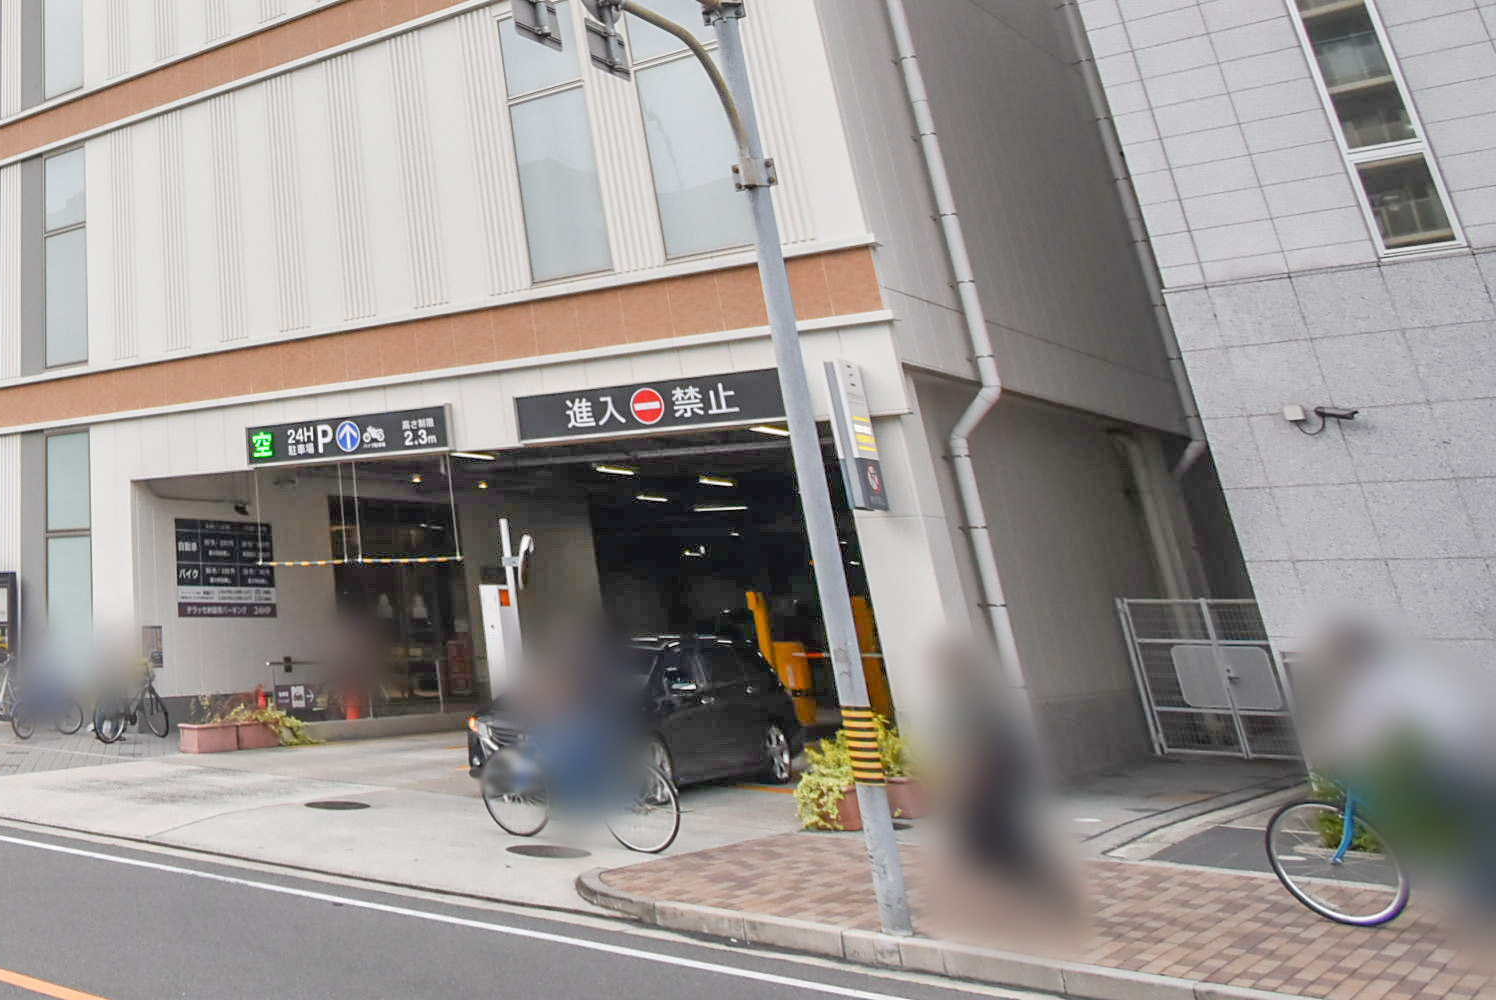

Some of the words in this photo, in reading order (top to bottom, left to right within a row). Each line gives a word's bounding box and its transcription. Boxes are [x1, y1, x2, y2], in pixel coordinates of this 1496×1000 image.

[565, 396, 627, 430] 進入
[671, 382, 741, 418] 禁止
[251, 432, 273, 458] 空
[287, 426, 314, 445] 24H
[316, 424, 333, 453] P
[287, 443, 315, 457] 駐車場
[403, 429, 437, 446] 2.3m
